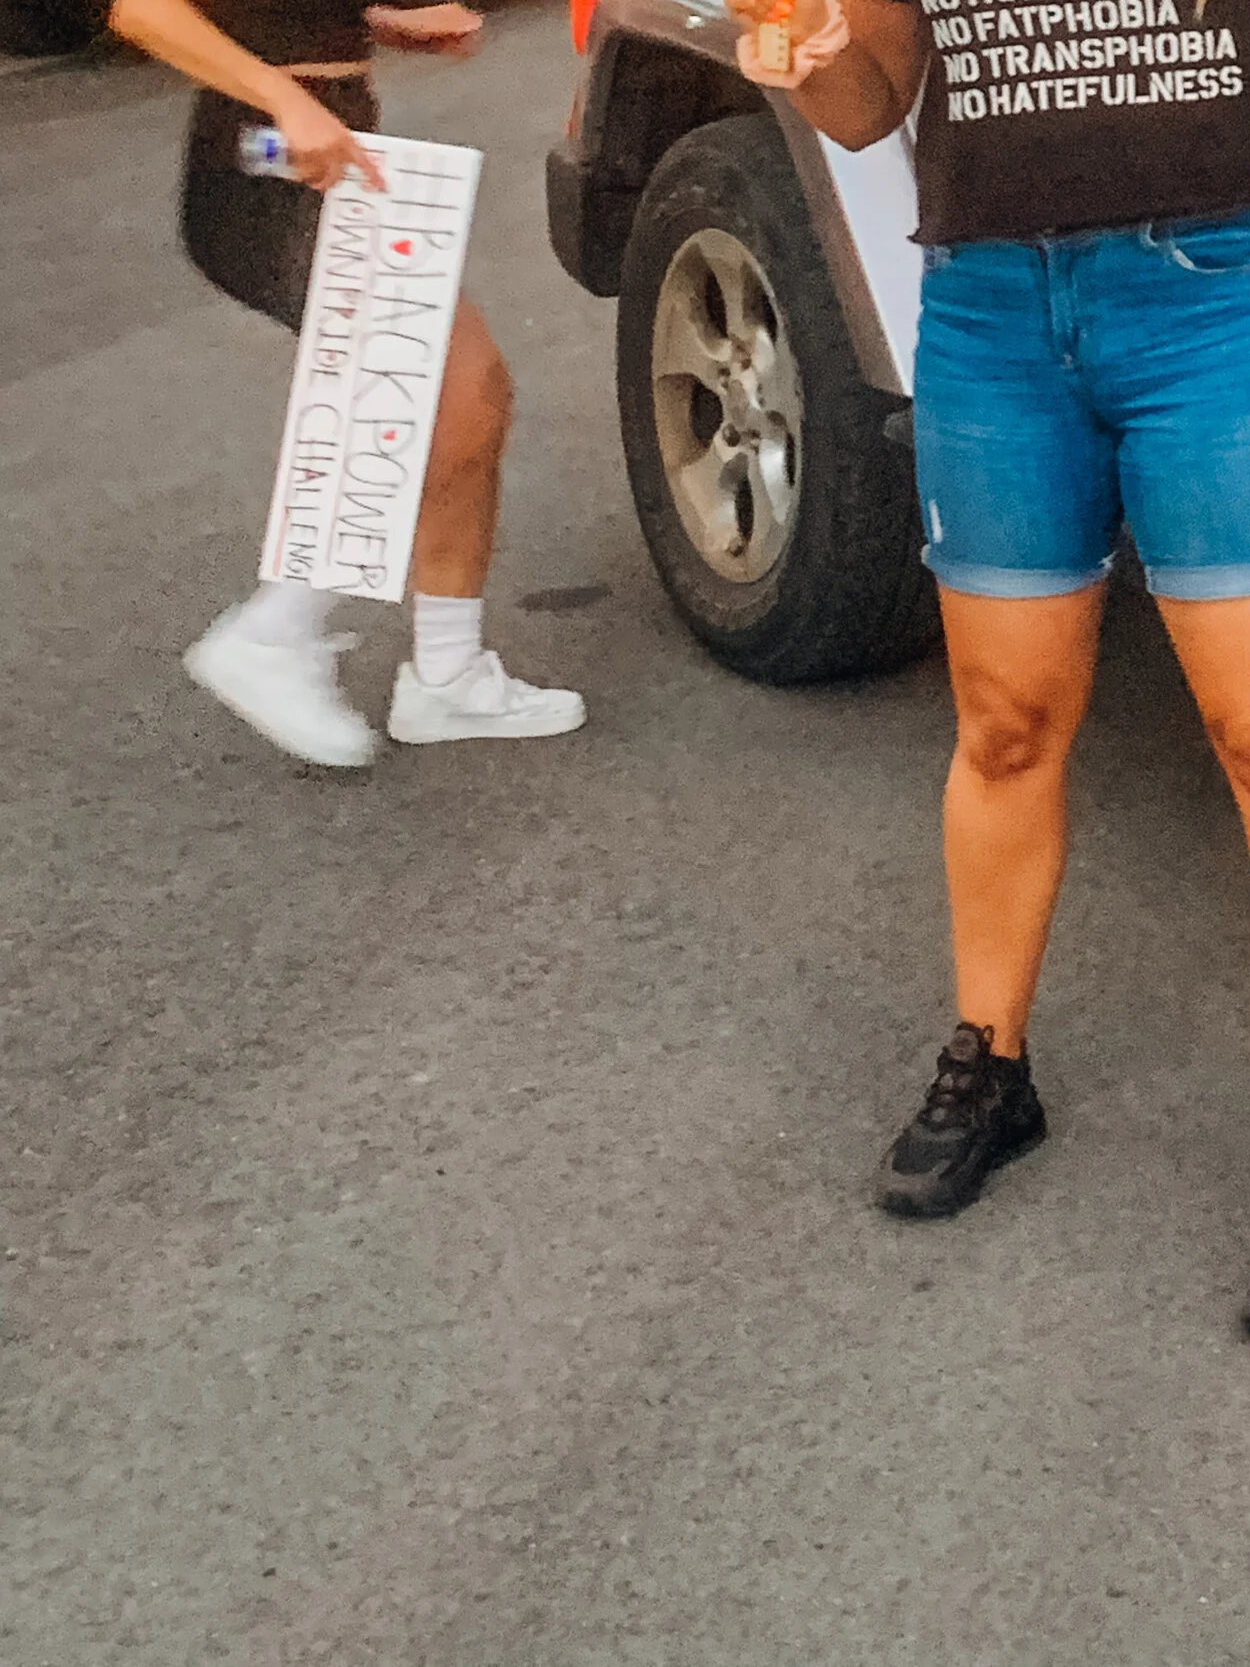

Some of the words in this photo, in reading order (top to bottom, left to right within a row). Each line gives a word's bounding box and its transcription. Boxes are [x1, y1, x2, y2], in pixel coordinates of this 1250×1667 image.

[931, 16, 973, 49] NO
[944, 51, 981, 84] NO
[982, 28, 1238, 79] TRANSPHOBIA
[948, 89, 986, 121] NO
[989, 65, 1244, 114] HATEFULNESS
